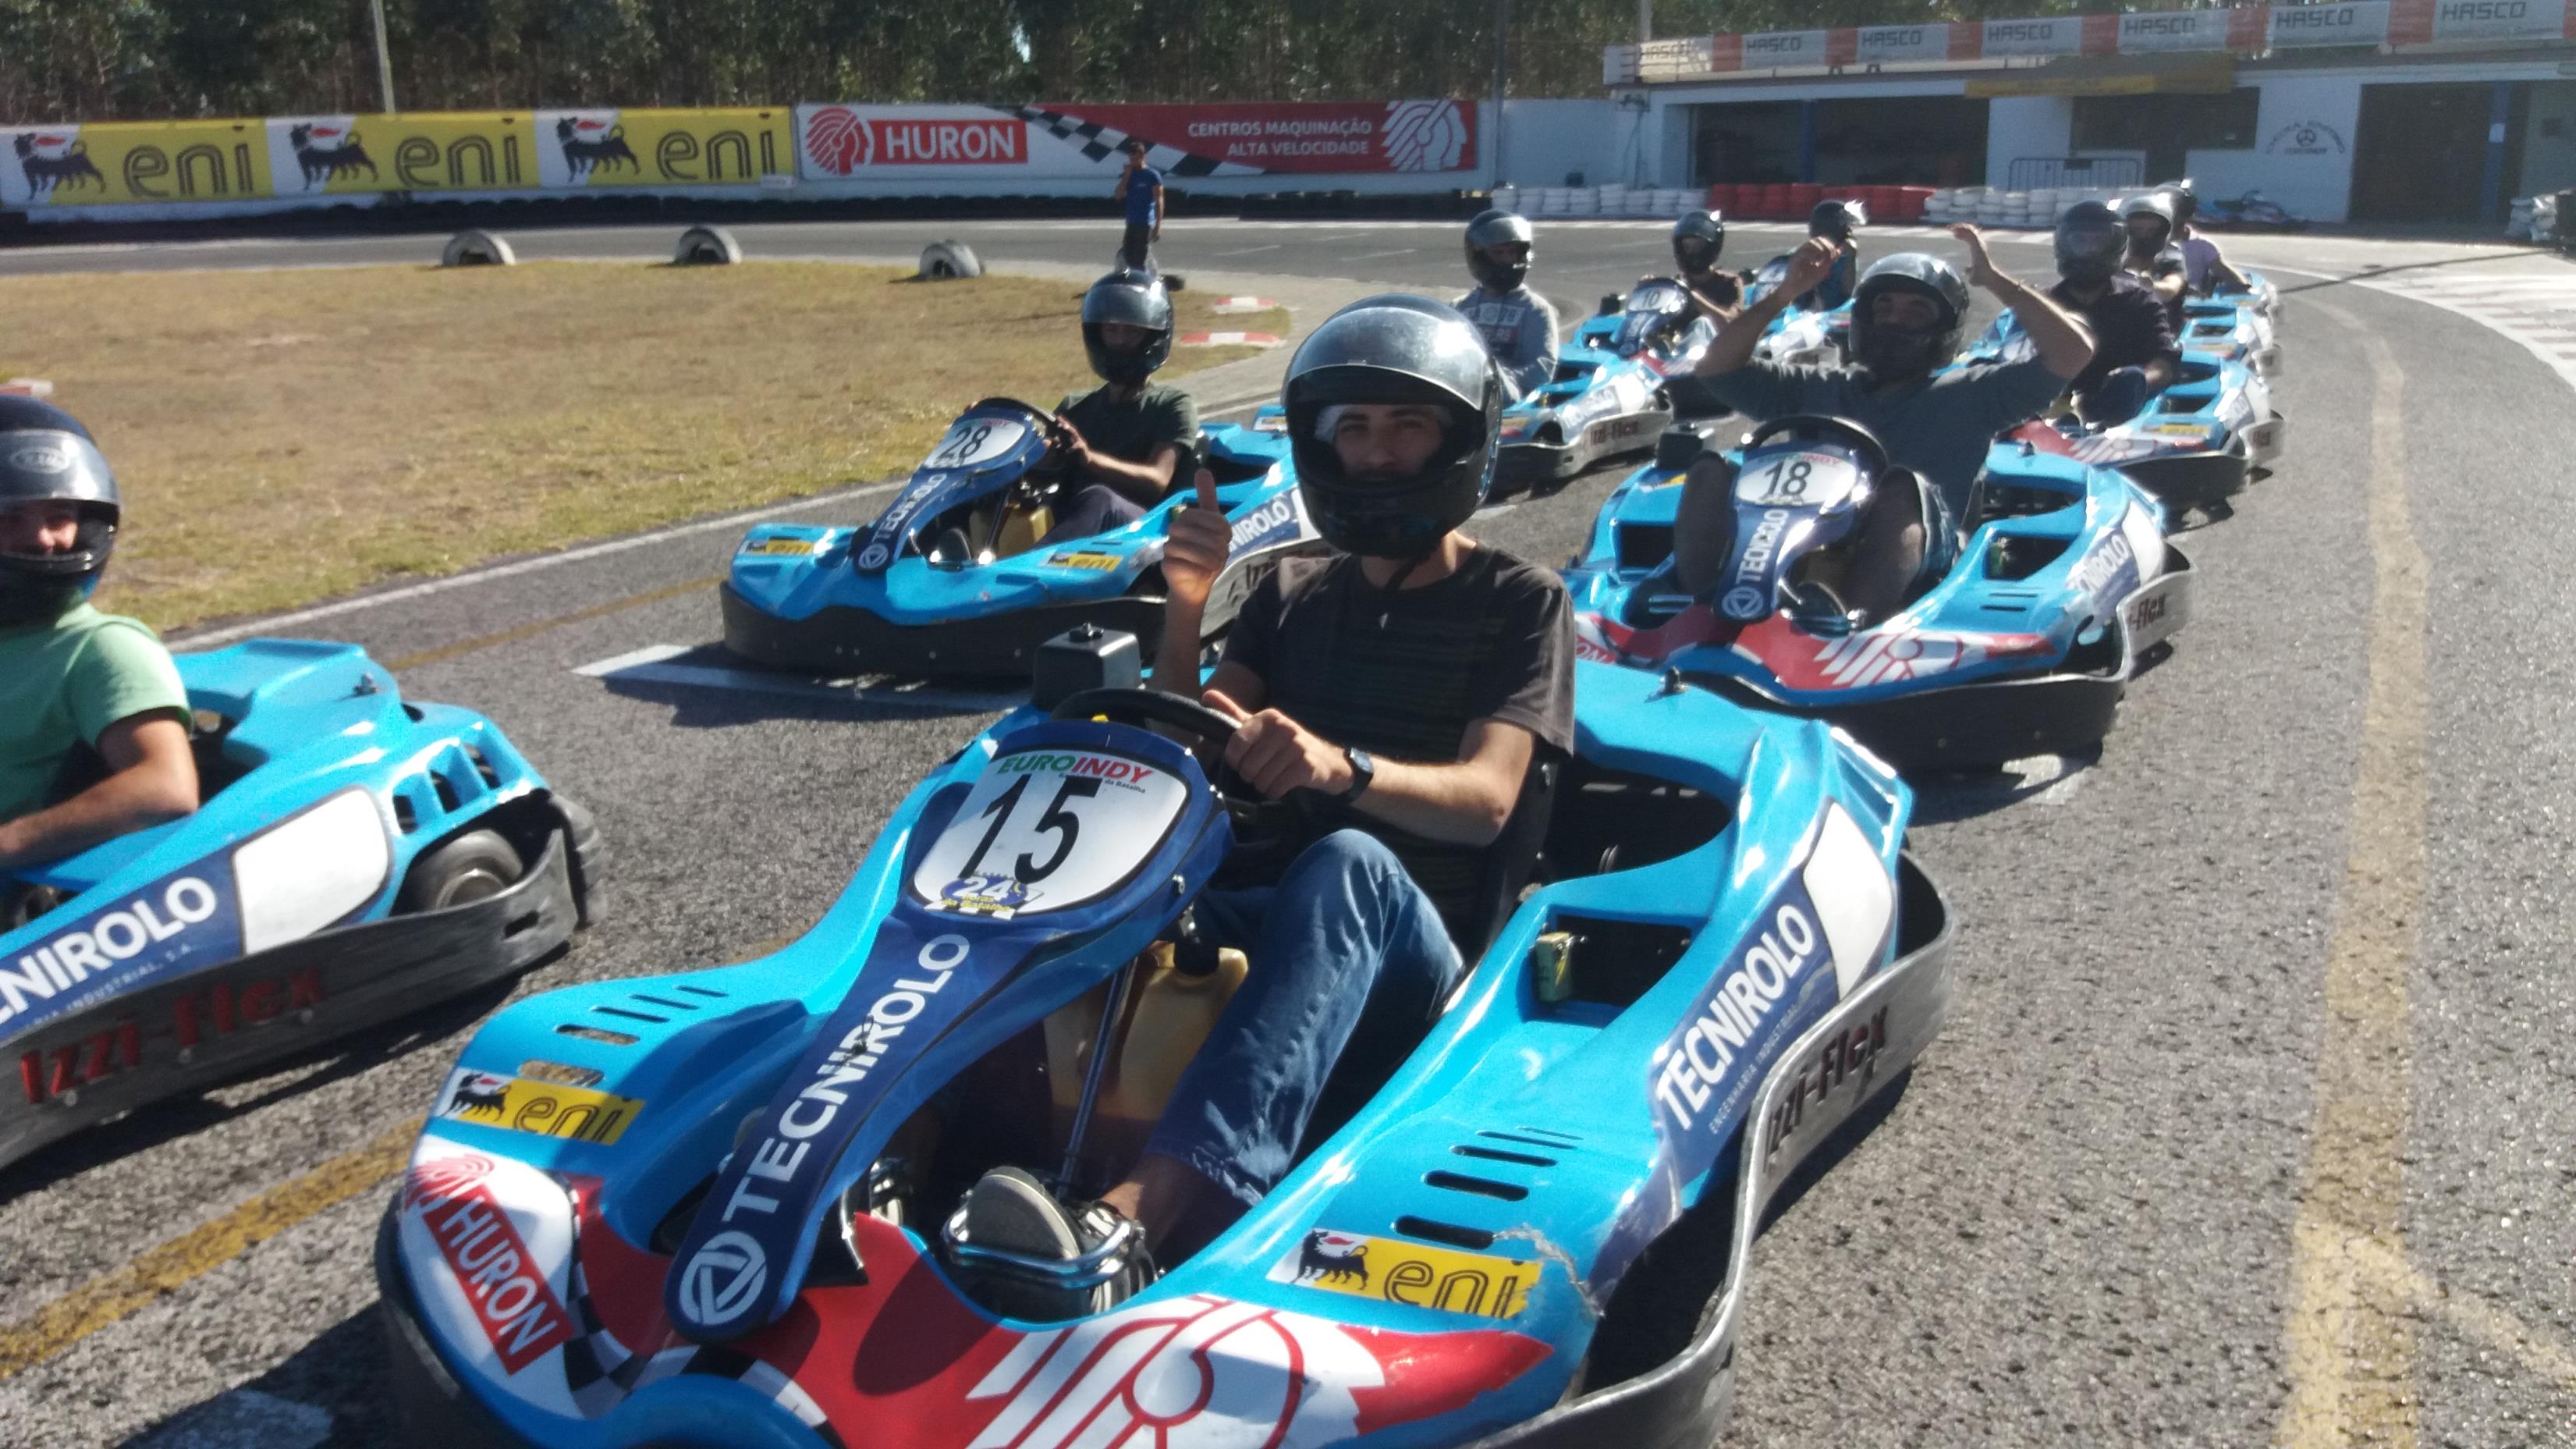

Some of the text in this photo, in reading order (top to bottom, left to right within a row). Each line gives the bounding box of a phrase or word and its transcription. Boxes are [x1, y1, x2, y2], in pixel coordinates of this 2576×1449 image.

[2124, 16, 2196, 36] HASCO
[2275, 8, 2354, 29] HASCO
[2442, 2, 2527, 20] HASCO
[1746, 36, 1801, 53] HASCO
[1862, 29, 1923, 47] HASCO
[1989, 23, 2053, 41] HASCO
[885, 124, 1015, 160] HURON
[1187, 117, 1372, 137] CENTROS MAQUINAÇÃO
[122, 125, 254, 198] eni
[396, 118, 522, 187] eni
[656, 113, 776, 180] eni
[1226, 140, 1370, 157] ALTA VELOCIDADE
[936, 425, 992, 460] 28
[1763, 460, 1811, 496] 18
[1229, 500, 1290, 552] NIROLO
[996, 754, 1154, 783] EUROINDY
[957, 773, 1103, 885] 15
[952, 875, 1015, 901] 24
[1656, 904, 1815, 1131] TECNIROLO
[721, 933, 970, 1223] TECNIROLO
[513, 1096, 633, 1142] eni
[439, 1195, 558, 1356] HURON
[1383, 1258, 1524, 1319] eni
